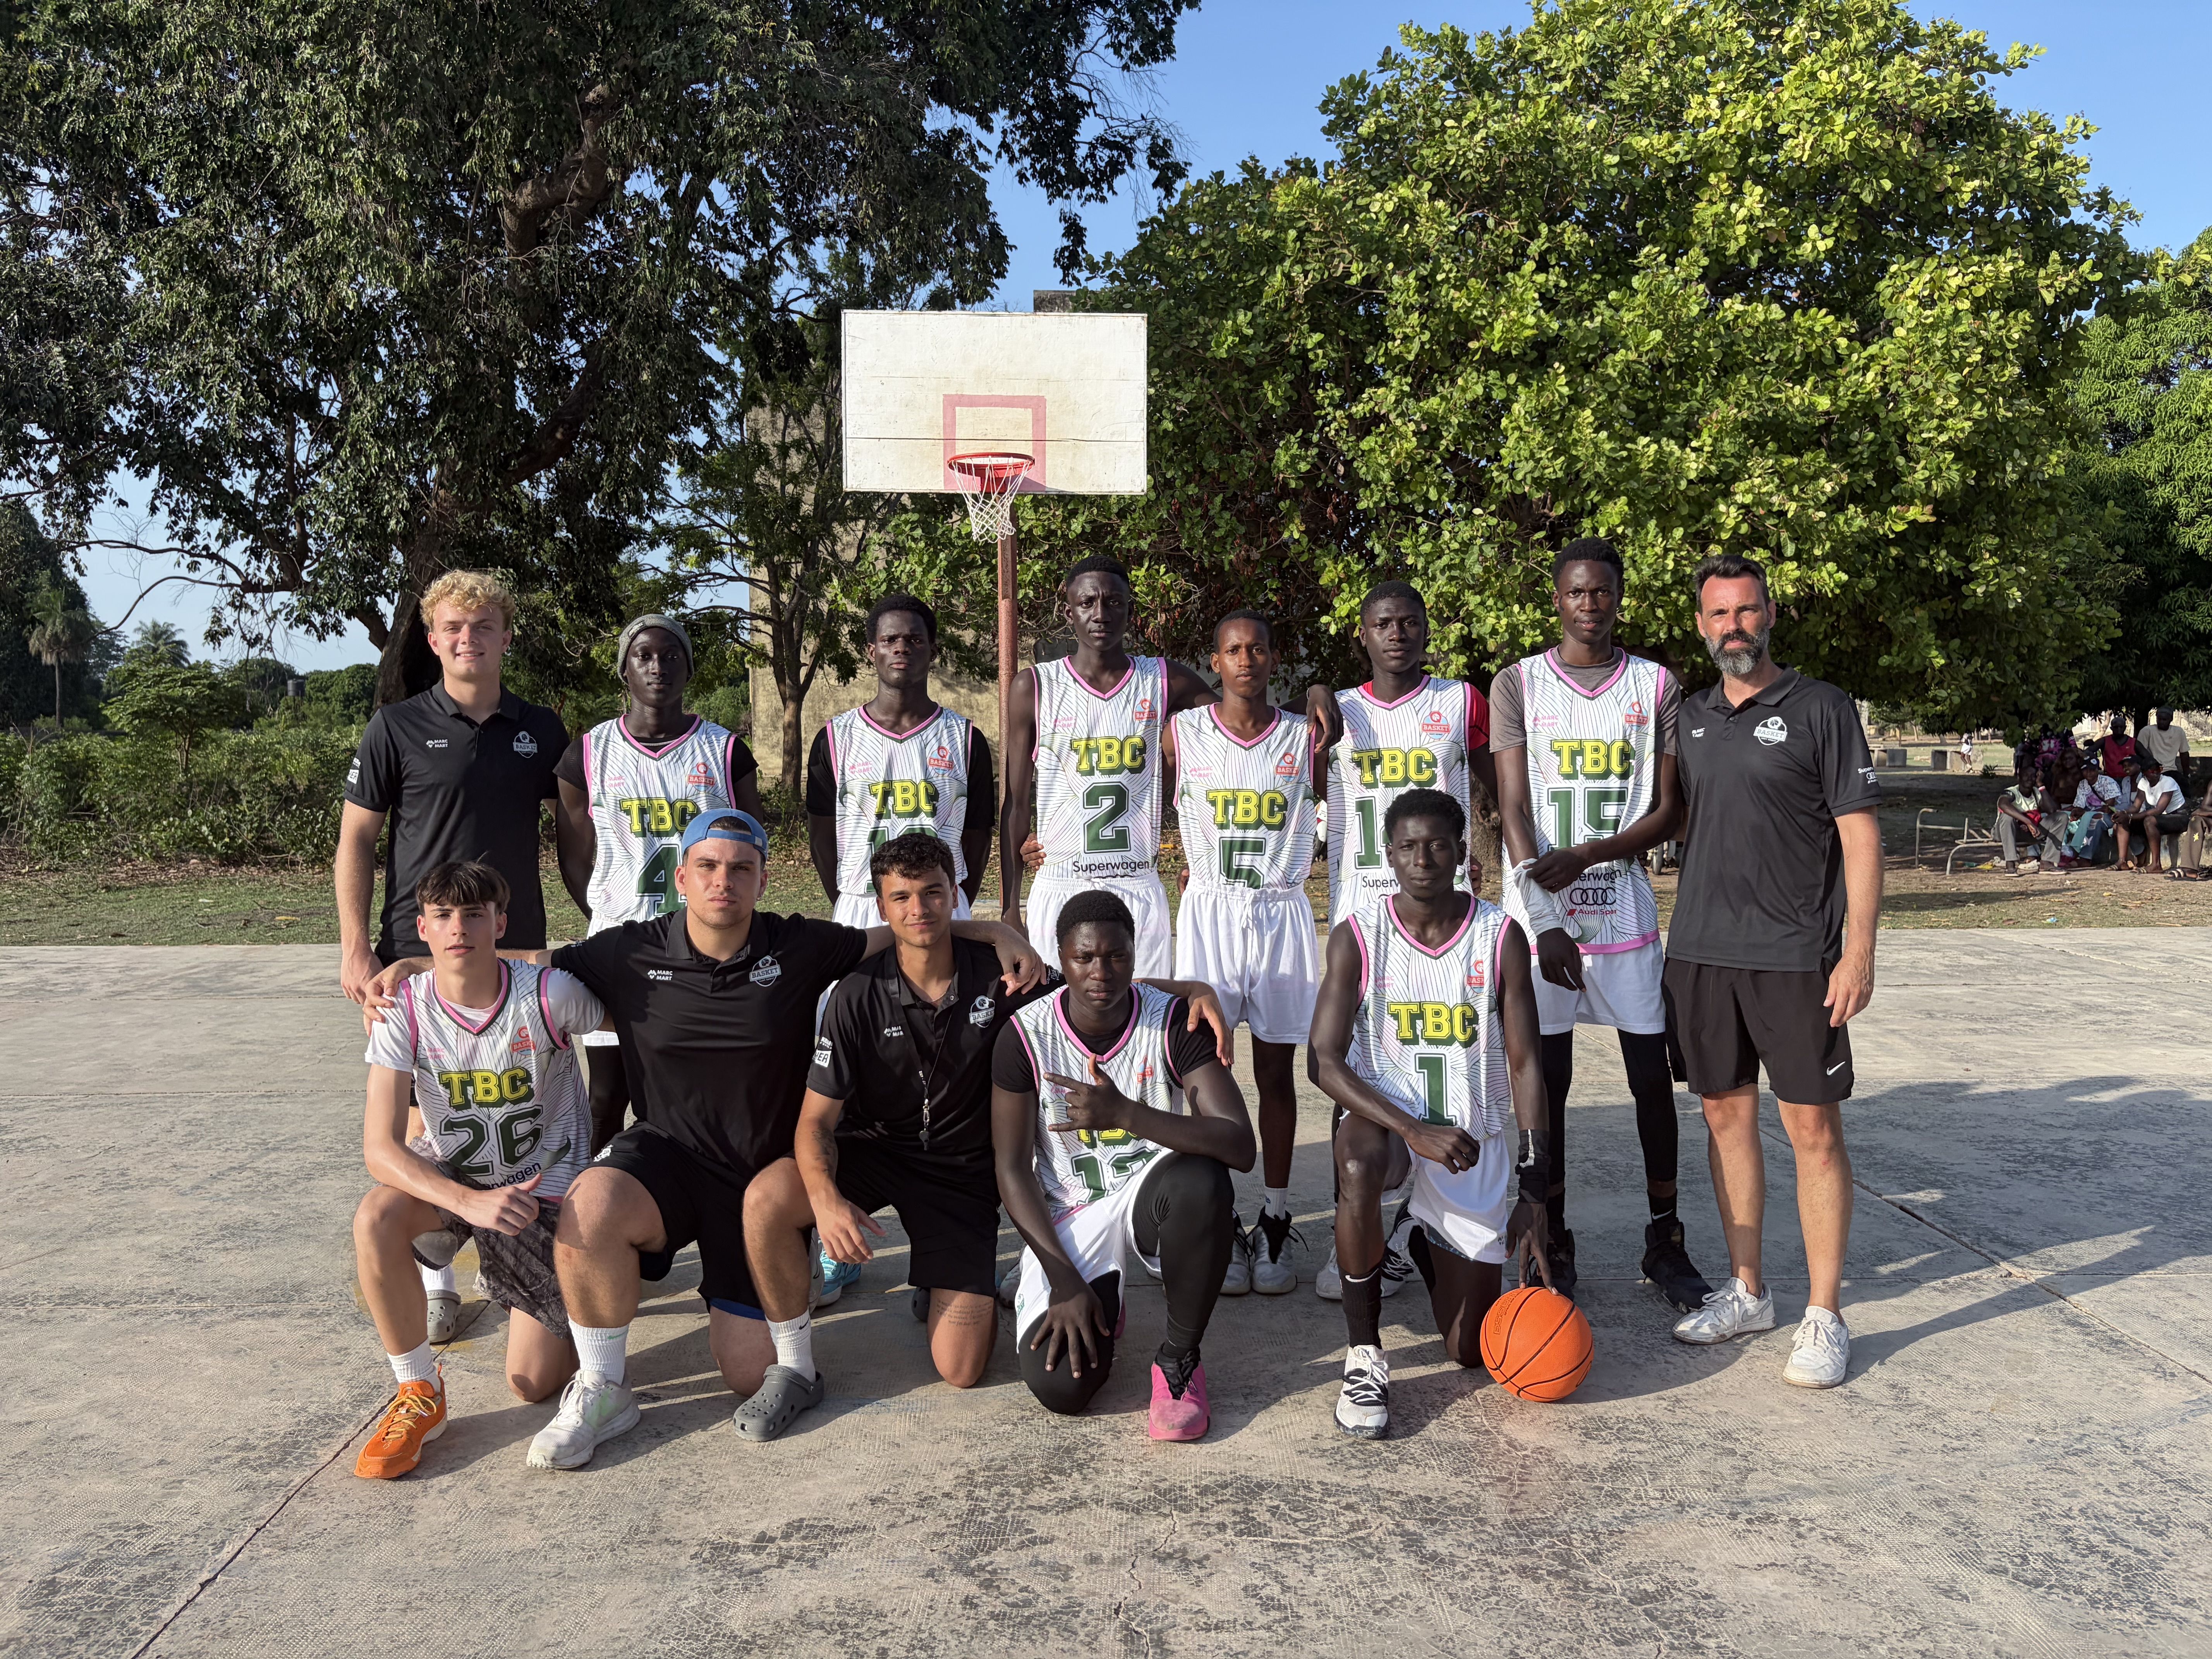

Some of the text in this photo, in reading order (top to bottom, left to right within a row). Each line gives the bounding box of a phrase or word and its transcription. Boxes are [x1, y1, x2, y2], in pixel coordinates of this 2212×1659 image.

[1430, 712, 1441, 723] Q
[1757, 729, 1784, 738] BASKET
[930, 759, 952, 768] BASKET
[1071, 736, 1146, 775] TBC
[1283, 753, 1294, 765] Q
[1352, 748, 1437, 787] TBC
[1550, 739, 1635, 778] TBC
[620, 798, 697, 836] TBC
[869, 780, 939, 818] TBC
[1083, 781, 1131, 854] 2
[1206, 789, 1288, 830] TBC
[1547, 787, 1629, 849] 15
[636, 844, 687, 916] 4
[1073, 861, 1149, 873] Superwagen
[1219, 836, 1266, 890] 5
[752, 967, 778, 978] BASKET
[972, 1010, 994, 1020] BASKE
[1387, 1002, 1476, 1044] TBC
[439, 1066, 531, 1109] TBC
[1415, 1053, 1456, 1127] 1
[439, 1104, 543, 1177] 26
